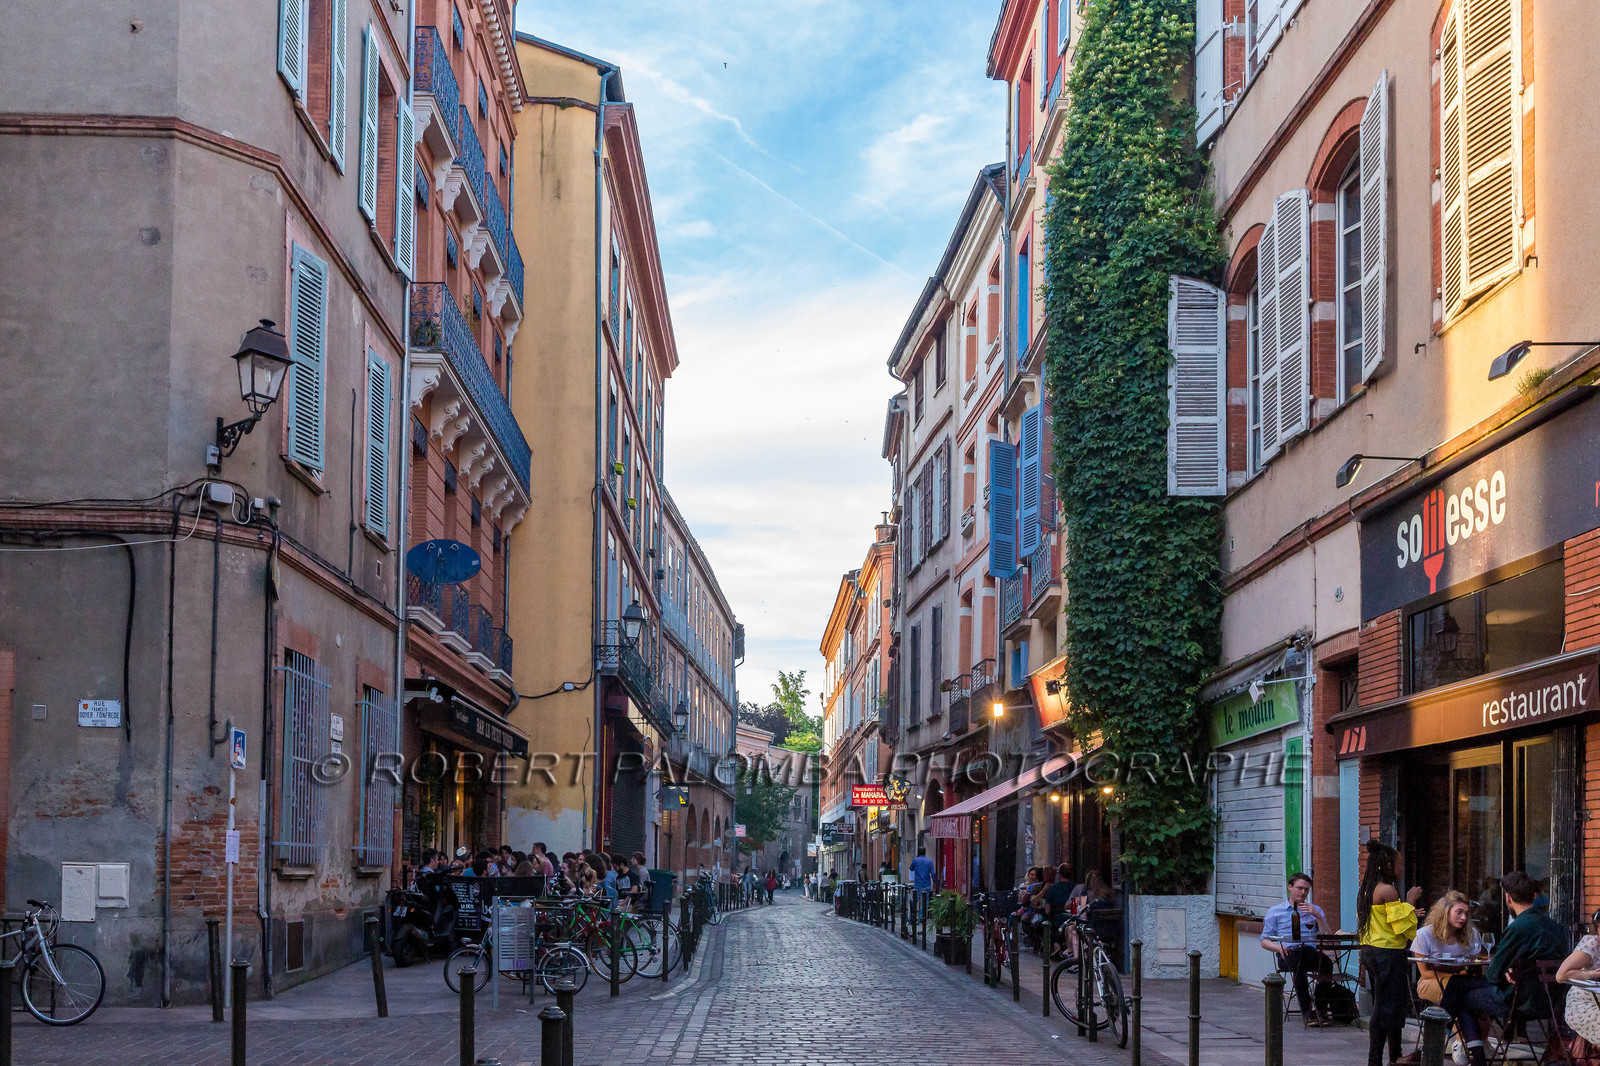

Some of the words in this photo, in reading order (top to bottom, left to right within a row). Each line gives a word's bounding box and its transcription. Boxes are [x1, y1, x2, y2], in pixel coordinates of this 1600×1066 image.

[1223, 706, 1233, 735] le
[1238, 699, 1275, 732] moulin
[1482, 673, 1587, 728] restaurant
